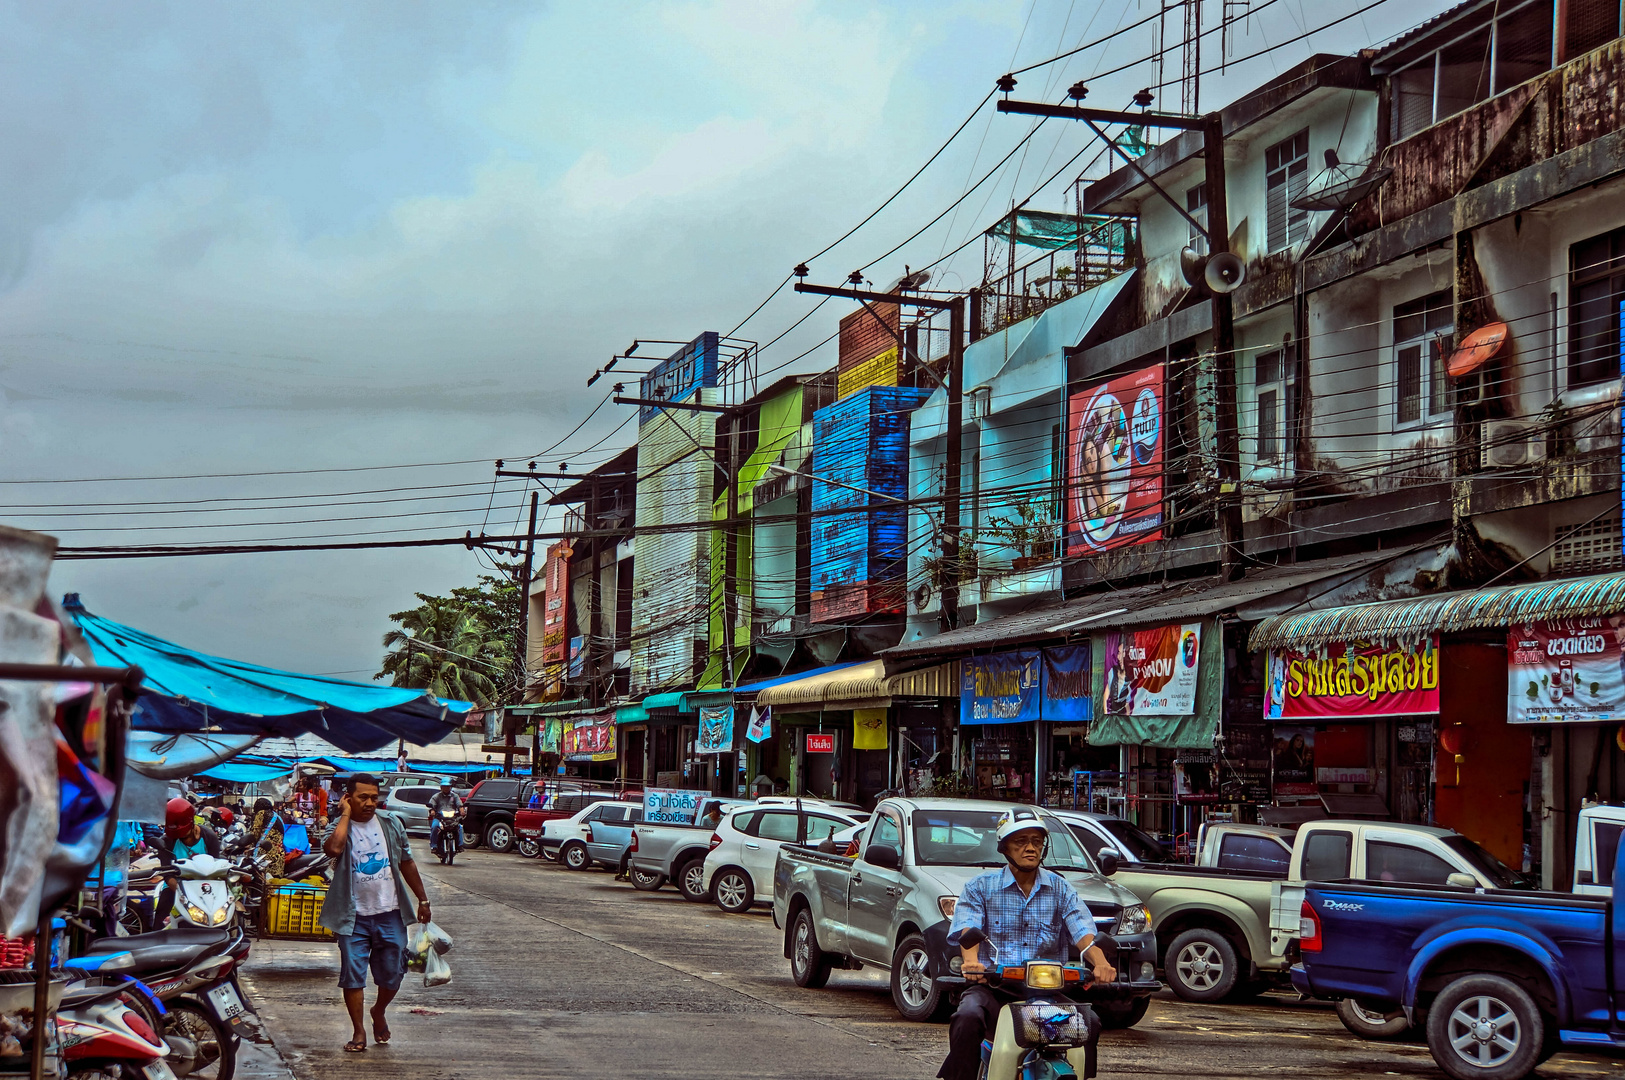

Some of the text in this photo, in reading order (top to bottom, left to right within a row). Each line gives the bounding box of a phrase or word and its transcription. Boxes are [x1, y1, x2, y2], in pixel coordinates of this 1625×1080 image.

[1135, 418, 1156, 436] TULIP
[1547, 630, 1606, 656] ขวดเดียว
[808, 738, 831, 749] ไจ้เส็ง
[648, 793, 697, 809] ร้านไจ้เส็ง
[224, 1003, 240, 1017] 866
